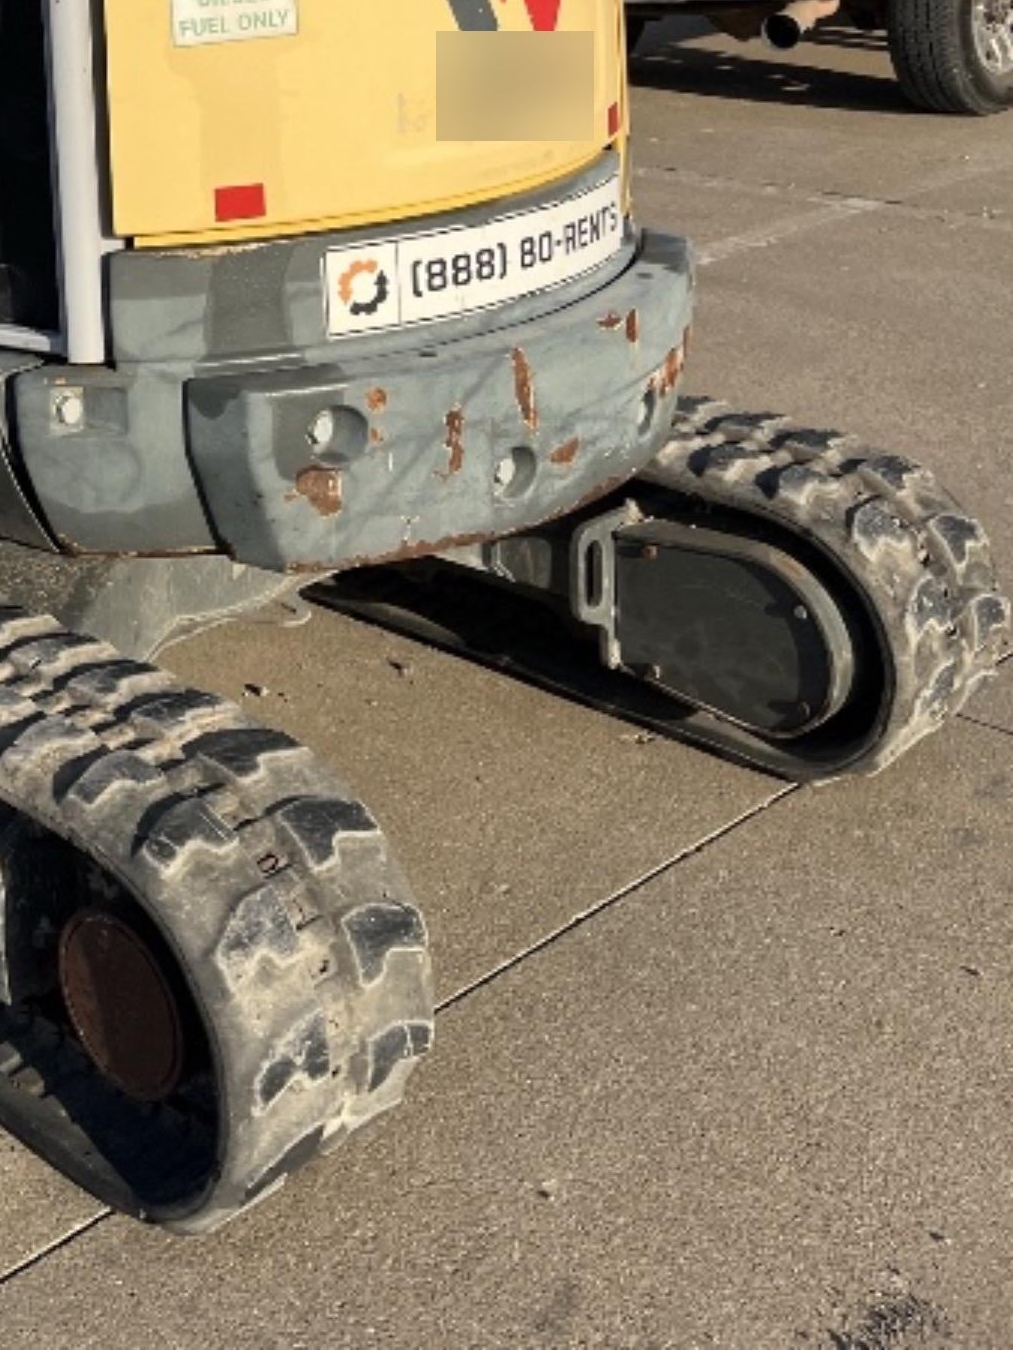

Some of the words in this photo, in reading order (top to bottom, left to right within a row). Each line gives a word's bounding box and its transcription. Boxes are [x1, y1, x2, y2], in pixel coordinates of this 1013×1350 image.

[178, 15, 229, 37] FUEL
[238, 8, 288, 32] ONLY
[411, 241, 508, 298] (888)
[519, 201, 619, 268] 80-RENTS
